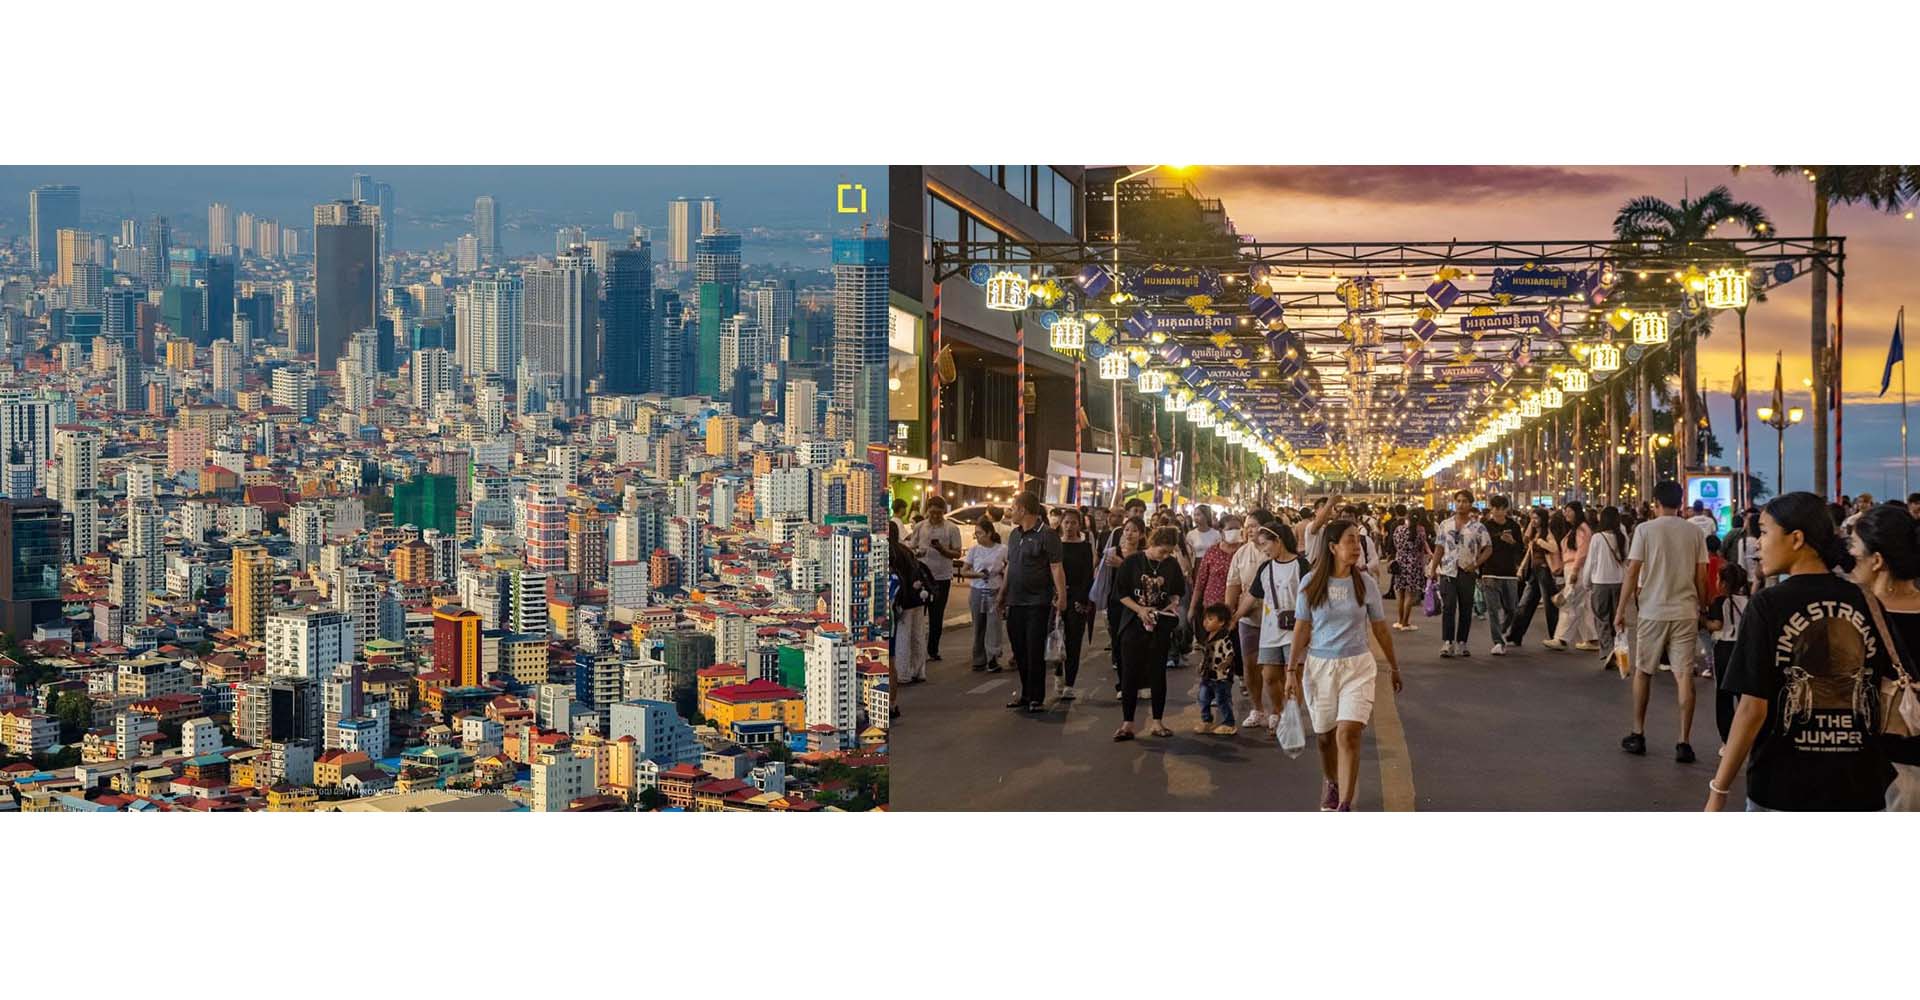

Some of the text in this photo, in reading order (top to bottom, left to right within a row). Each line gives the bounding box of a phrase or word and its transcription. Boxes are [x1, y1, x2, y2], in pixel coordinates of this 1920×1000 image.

[1157, 315, 1232, 330] អរគុណសន្តិភាព
[1466, 314, 1540, 329] អរគុណសន្តិភាព
[1206, 370, 1251, 378] VATTANAC
[1441, 367, 1486, 376] VATTANAC
[1775, 600, 1877, 667] TIME STREAM
[1815, 714, 1853, 729] THE
[1794, 731, 1863, 745] JUMPER
